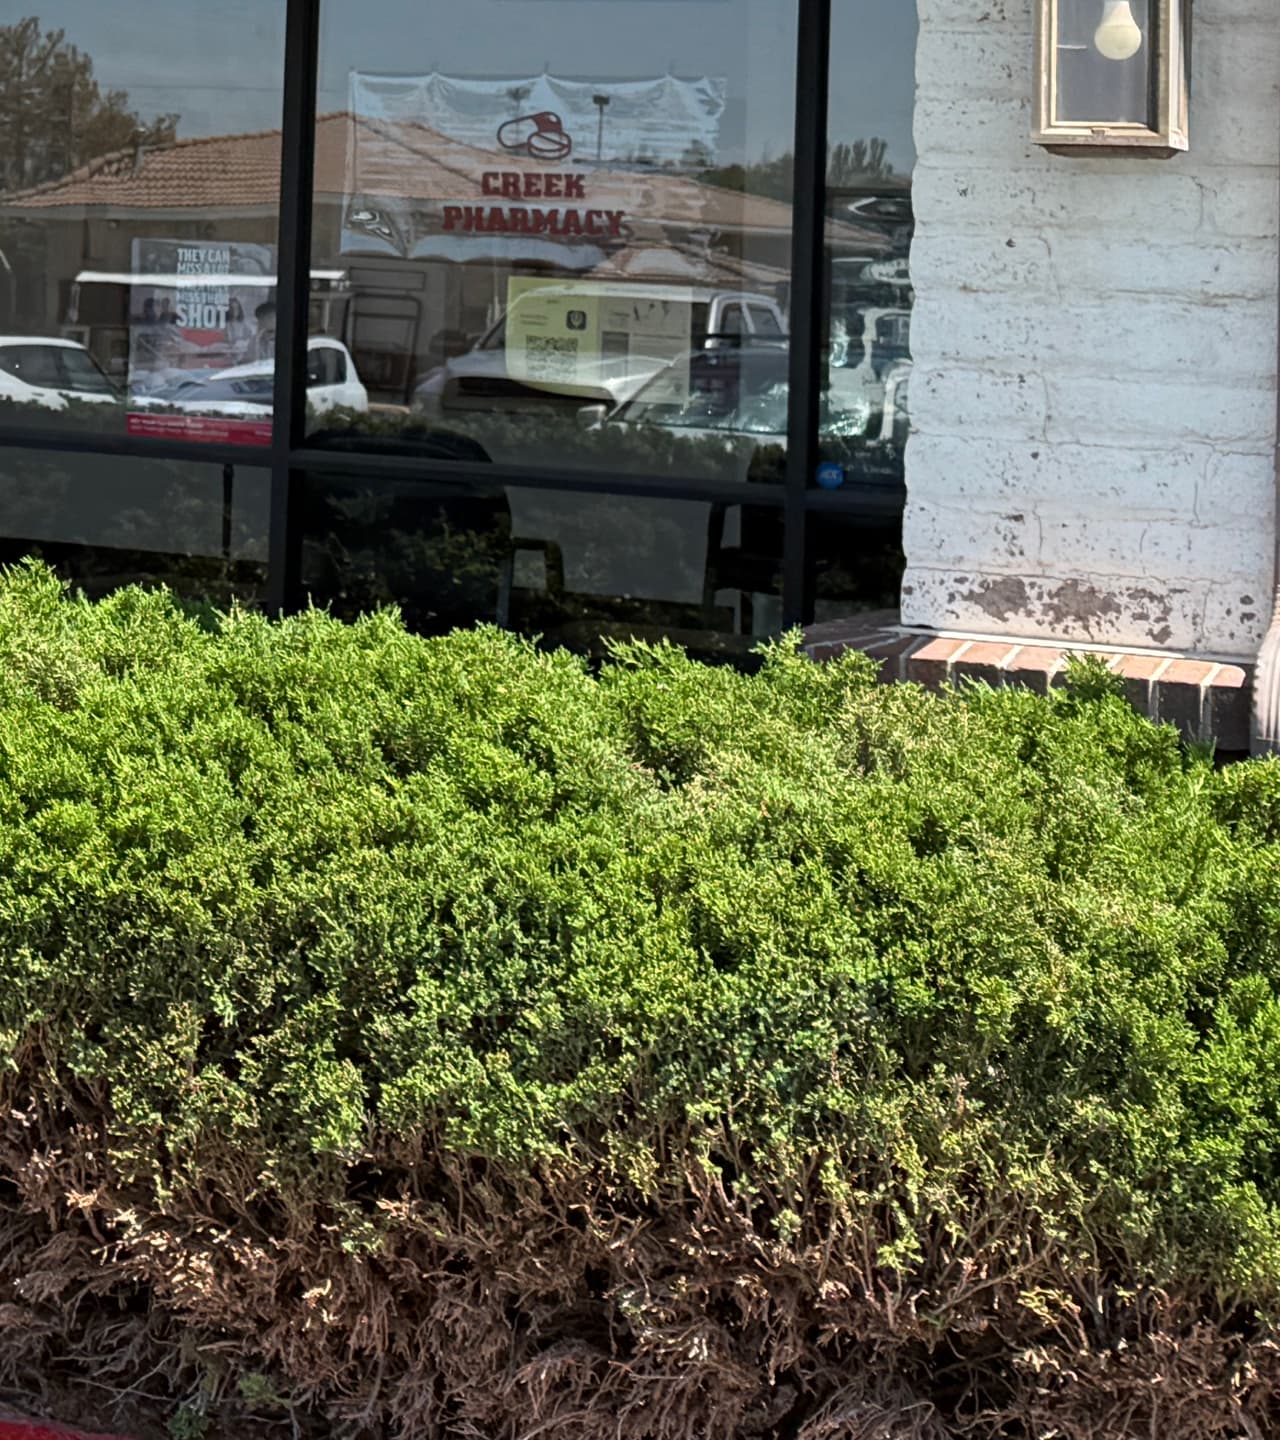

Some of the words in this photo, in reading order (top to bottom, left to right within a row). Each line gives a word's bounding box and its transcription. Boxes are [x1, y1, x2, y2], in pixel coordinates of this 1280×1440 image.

[481, 171, 586, 199] CREEK
[441, 205, 626, 236] PHARMACY
[177, 247, 207, 262] THEY
[207, 248, 231, 264] CAN
[175, 303, 230, 329] SHOT
